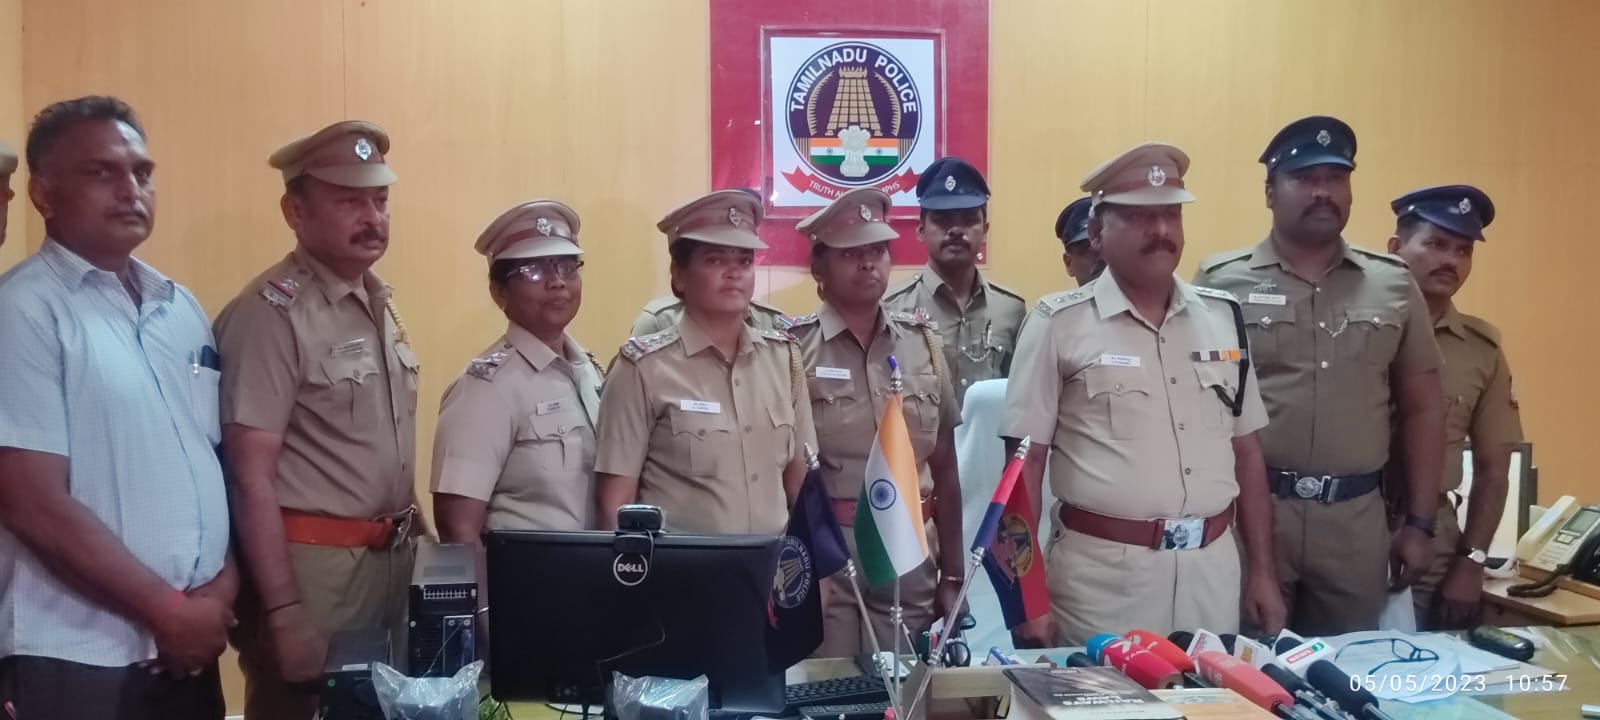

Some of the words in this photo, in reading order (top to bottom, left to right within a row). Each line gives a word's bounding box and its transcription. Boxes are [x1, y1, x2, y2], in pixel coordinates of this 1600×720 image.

[790, 47, 868, 112] TAMILNADU
[874, 54, 917, 114] POLICE
[809, 180, 835, 197] TRUTH
[617, 563, 644, 573] DELL
